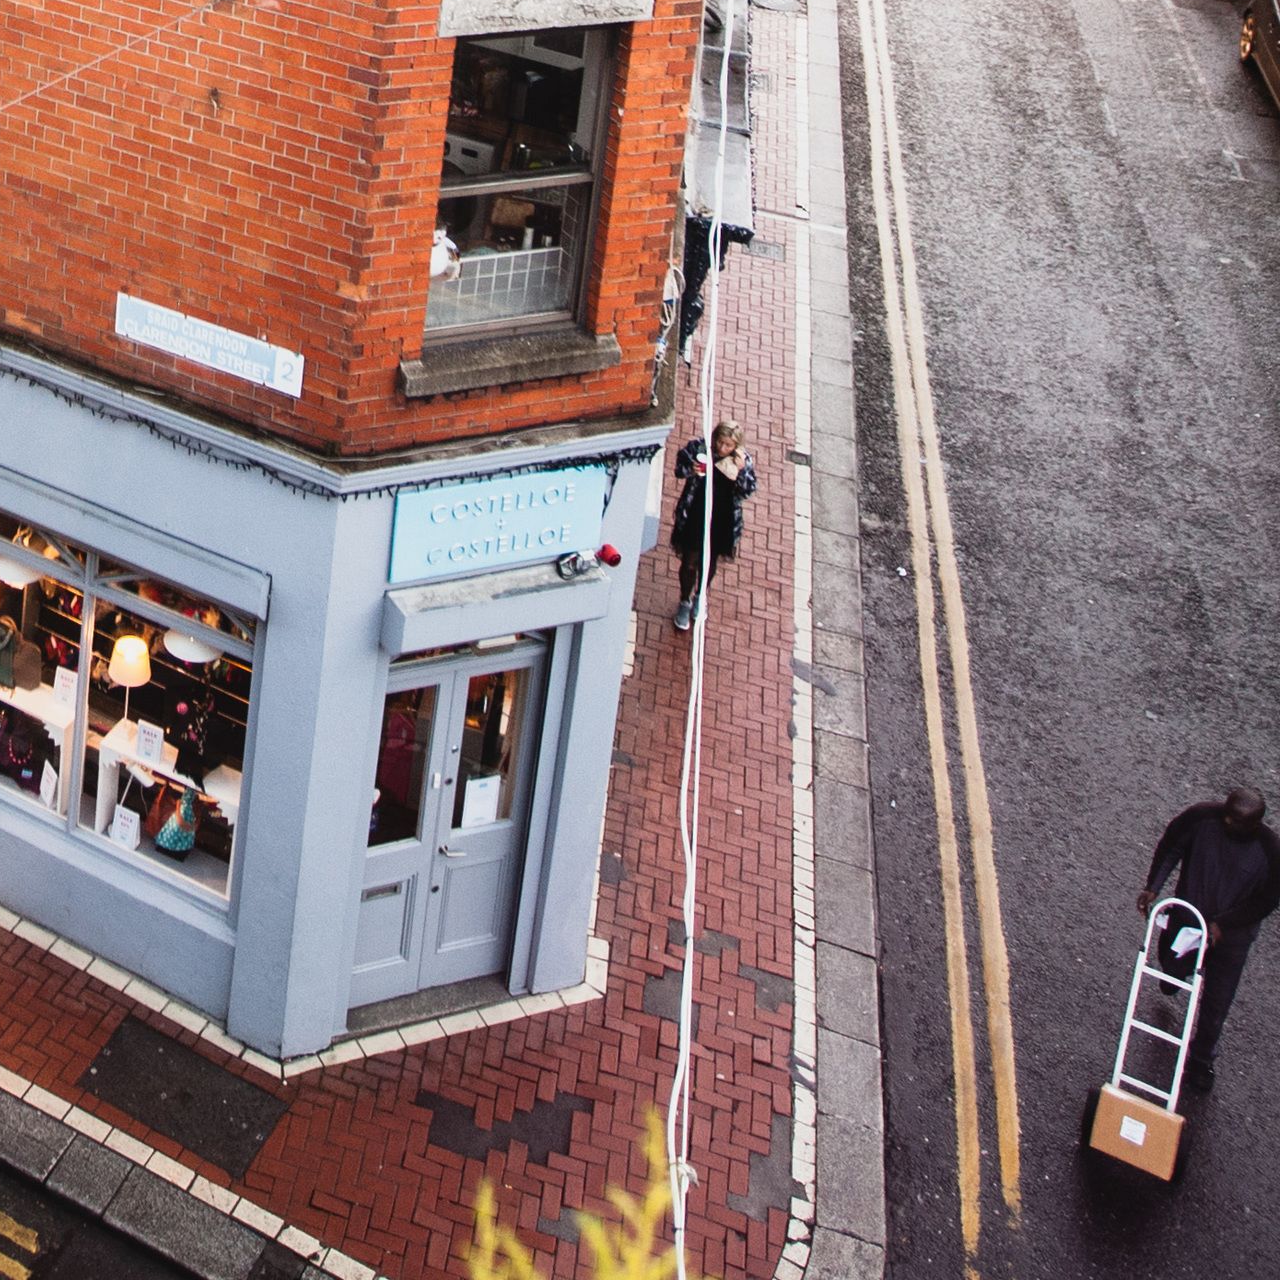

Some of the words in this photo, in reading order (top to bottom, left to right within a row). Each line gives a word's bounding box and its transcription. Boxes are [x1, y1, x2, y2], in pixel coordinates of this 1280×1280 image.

[124, 319, 211, 361] CLARENDON
[216, 352, 271, 379] STREET
[281, 361, 294, 382] 2
[182, 322, 248, 355] CLARENDON
[430, 482, 576, 524] COSTELLOE
[426, 523, 571, 565] COSTELLOE
